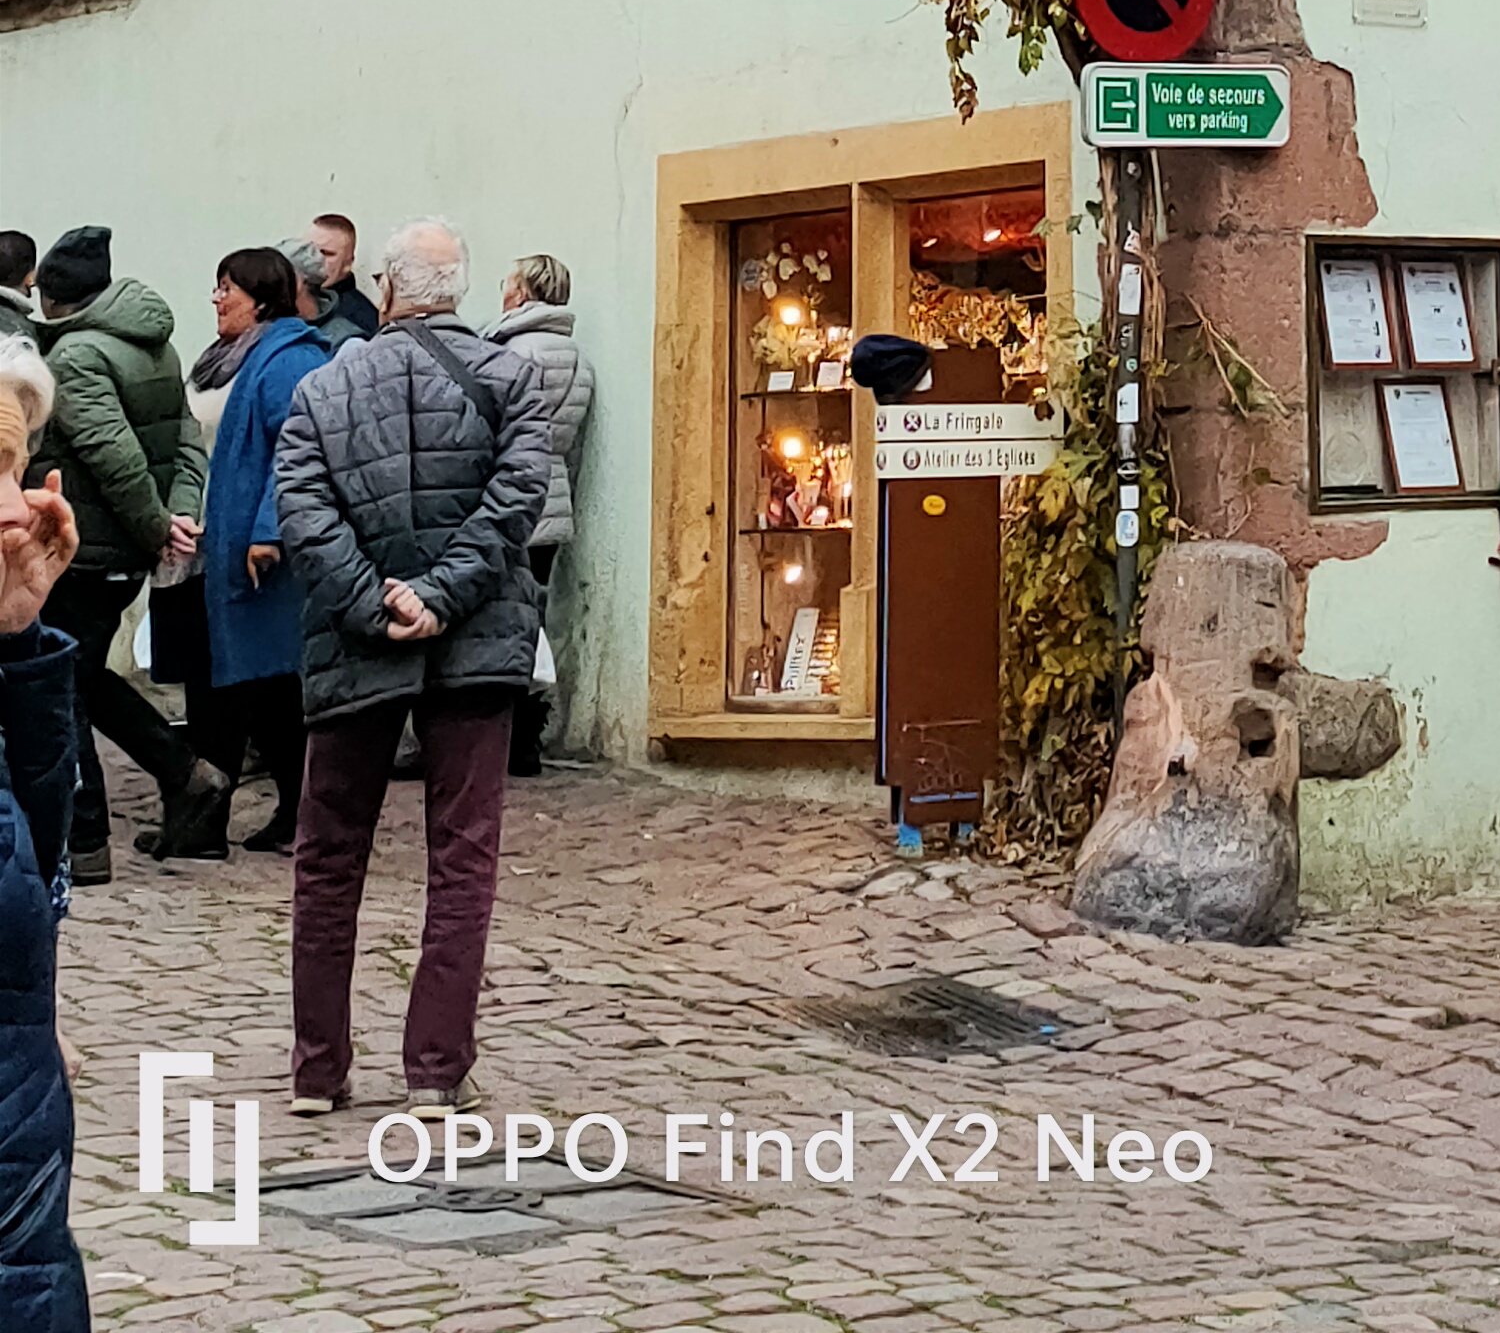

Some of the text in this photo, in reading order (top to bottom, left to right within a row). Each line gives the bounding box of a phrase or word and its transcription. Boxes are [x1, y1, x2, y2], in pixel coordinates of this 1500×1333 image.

[1151, 82, 1266, 105] Voie de secours
[1168, 111, 1248, 133] vers parking
[924, 412, 939, 430] La
[965, 449, 983, 467] des
